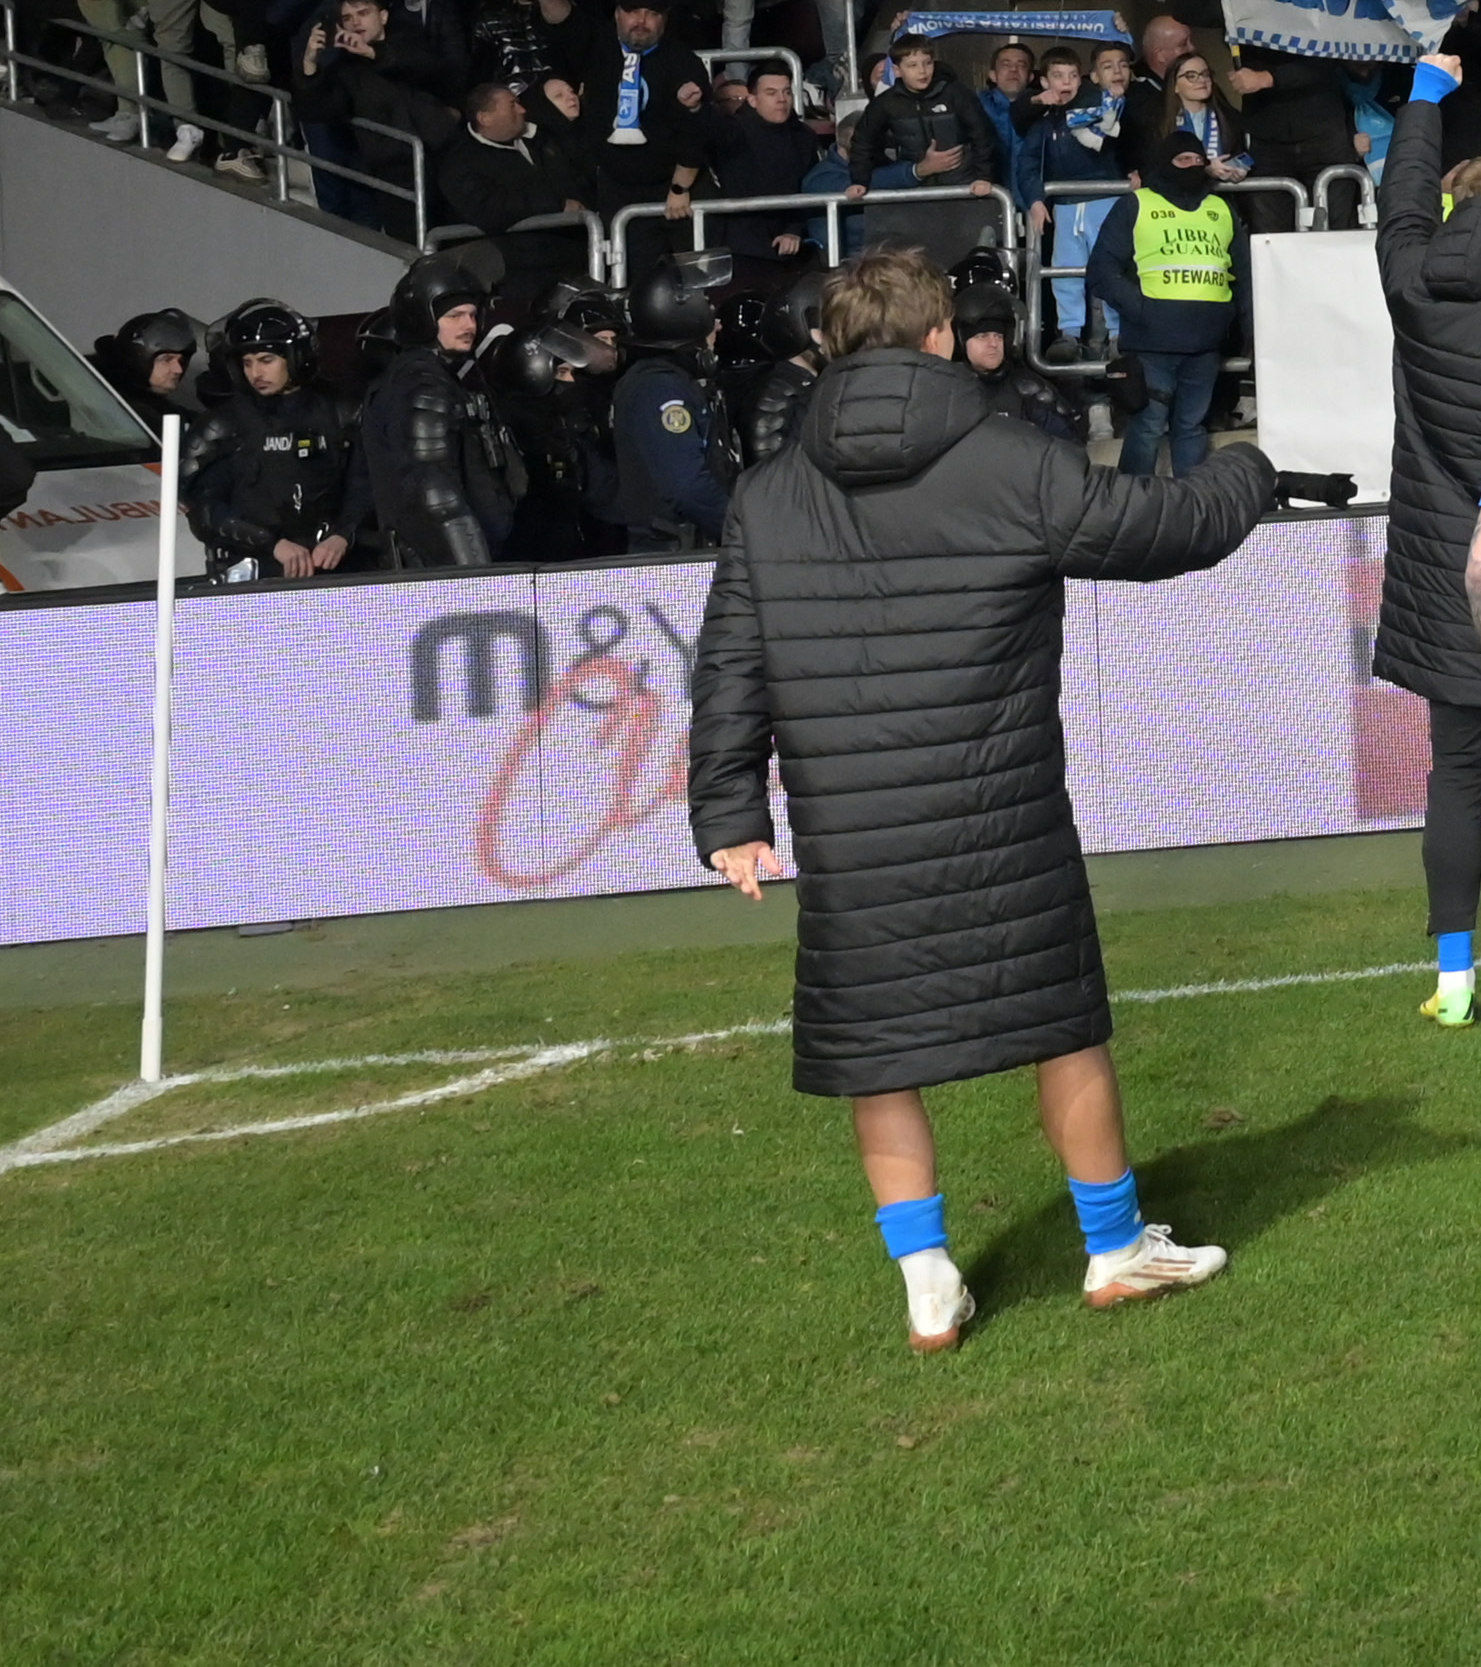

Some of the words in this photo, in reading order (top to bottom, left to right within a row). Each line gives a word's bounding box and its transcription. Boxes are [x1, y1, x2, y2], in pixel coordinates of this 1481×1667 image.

[907, 20, 976, 35] CRAIOVA
[979, 19, 1105, 34] UNIVERSITATEA
[1151, 210, 1176, 220] 038
[1163, 228, 1221, 248] LIBRA
[1162, 269, 1226, 287] STEWARD
